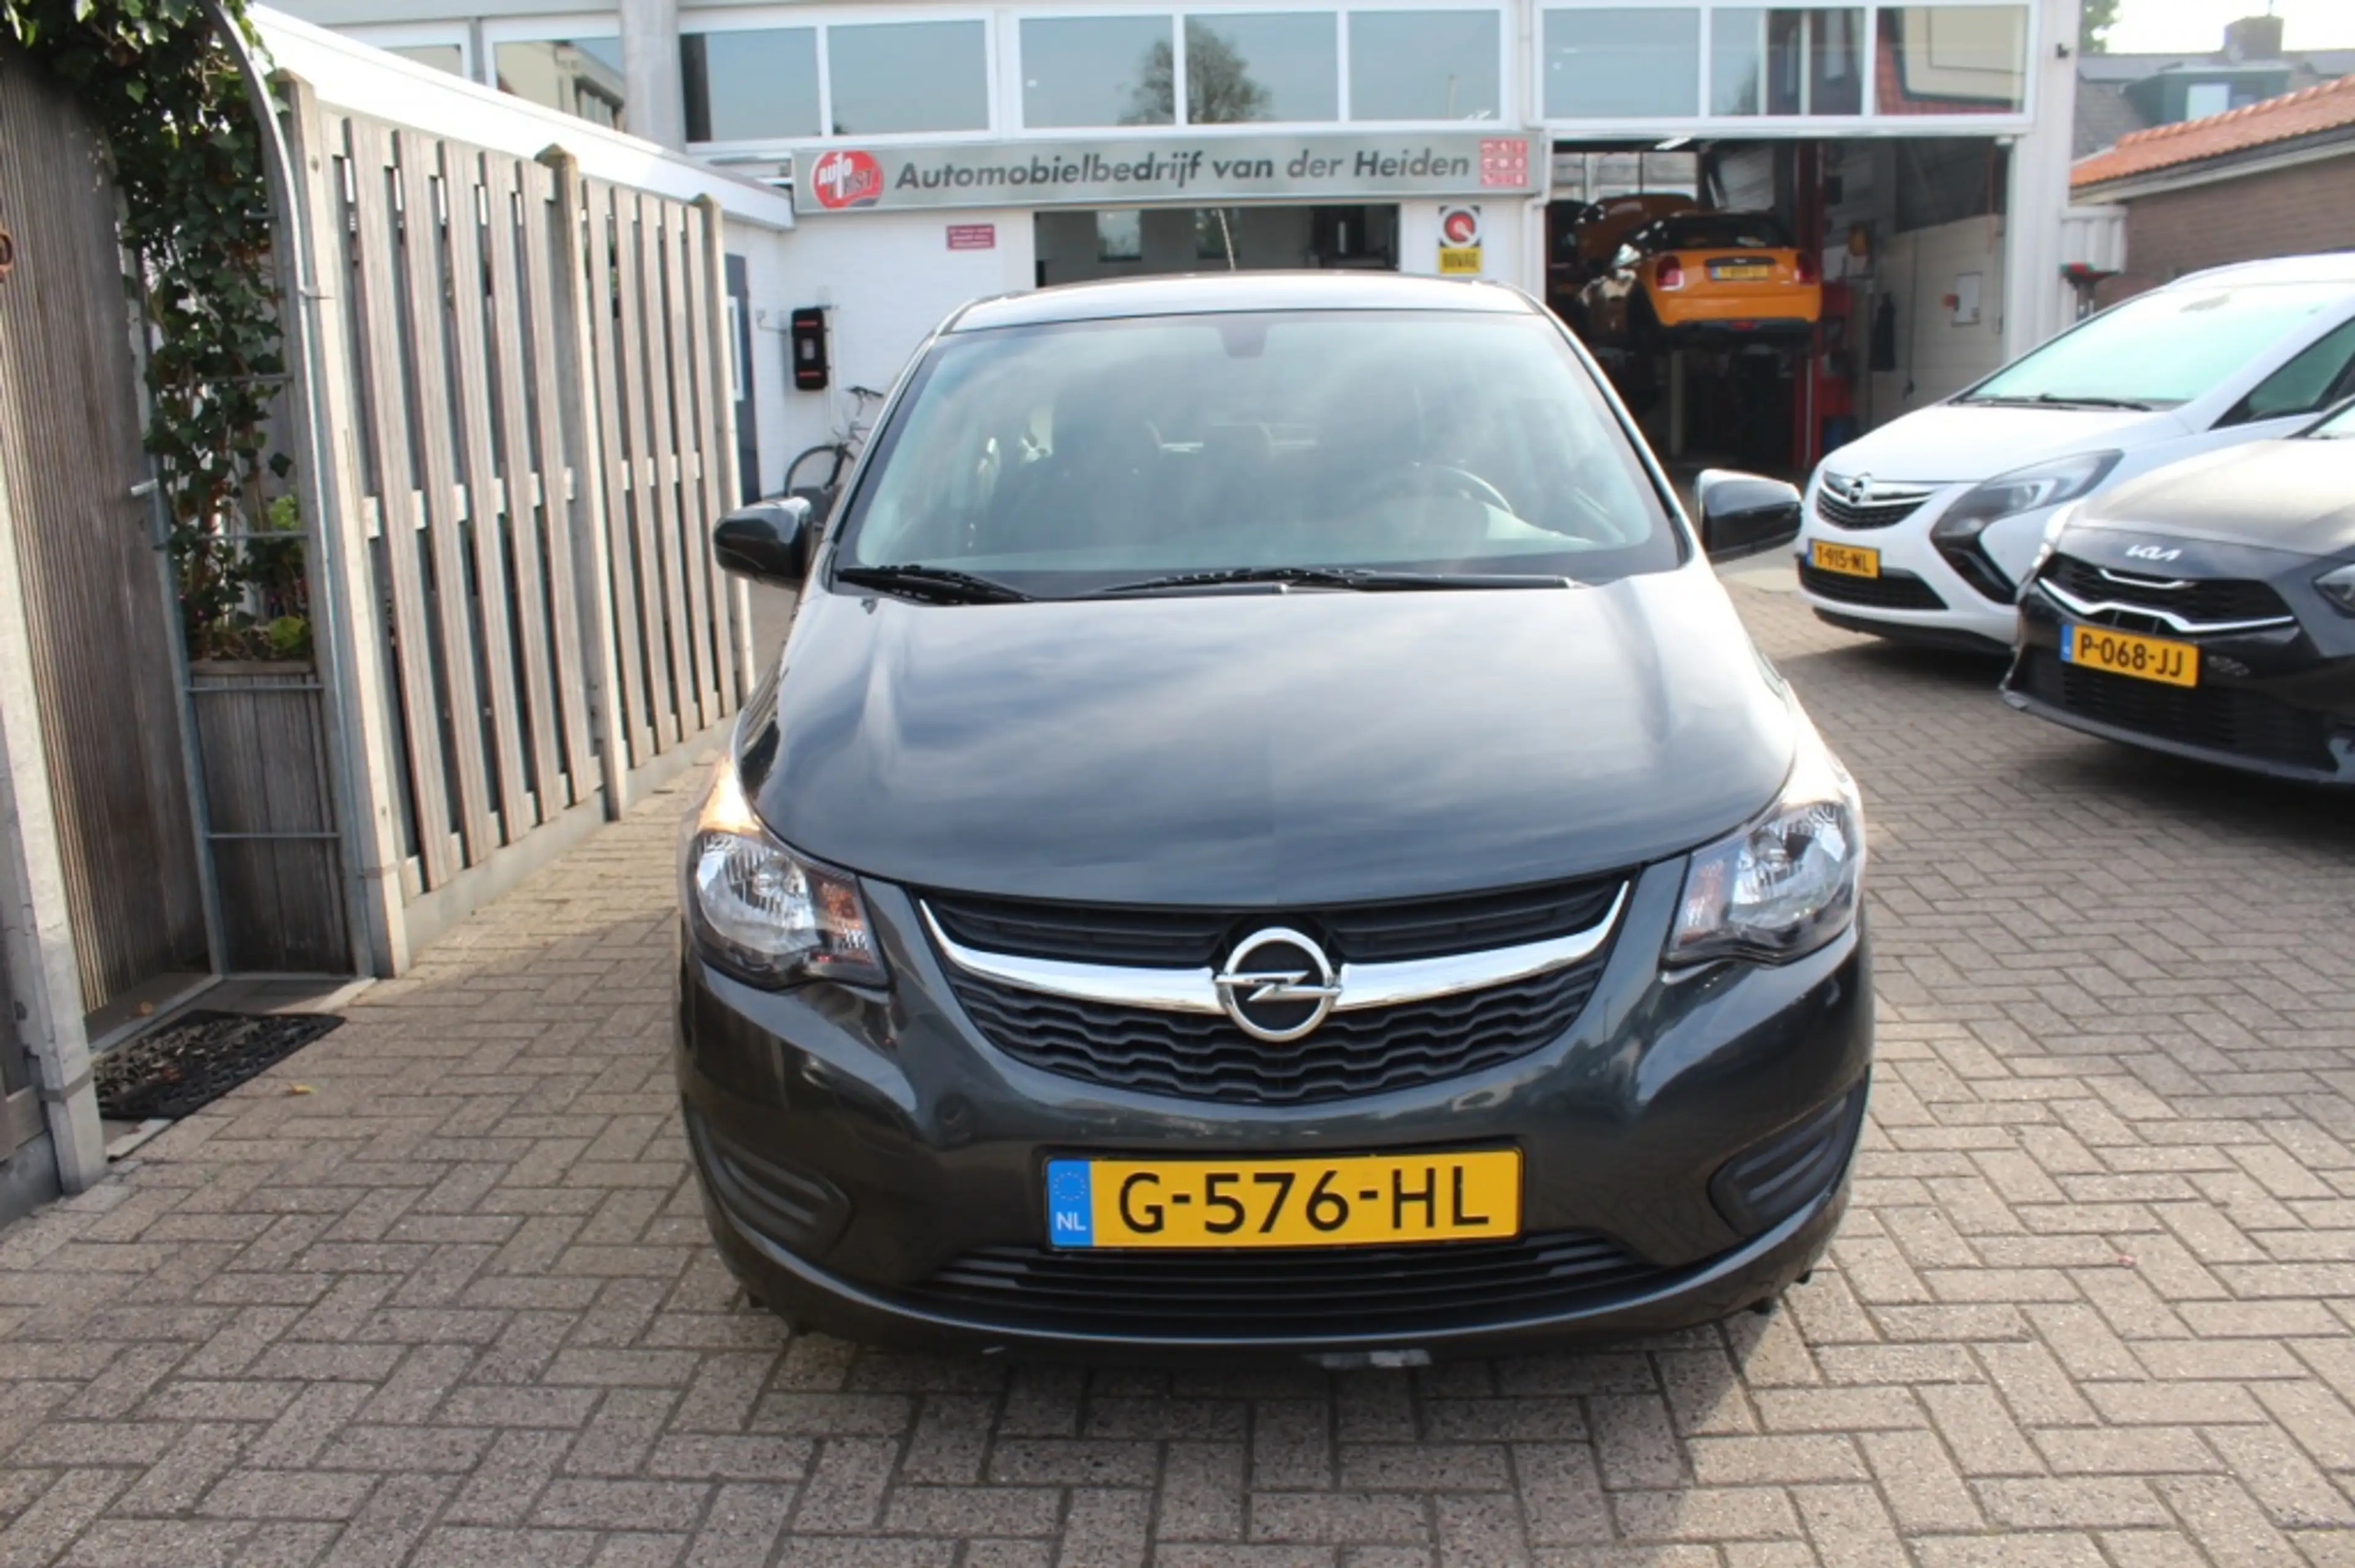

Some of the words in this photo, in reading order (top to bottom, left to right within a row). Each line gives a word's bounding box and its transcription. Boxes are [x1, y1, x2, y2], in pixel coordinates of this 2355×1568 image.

[895, 150, 1204, 189] Automobielbedrijf
[1212, 158, 1274, 180] van
[1287, 149, 1344, 178] der
[1353, 147, 1471, 178] Heiden
[2079, 632, 2184, 678] P-068-JJ
[1055, 1211, 1087, 1231] NL
[1119, 1166, 1490, 1235] G-576-HL
